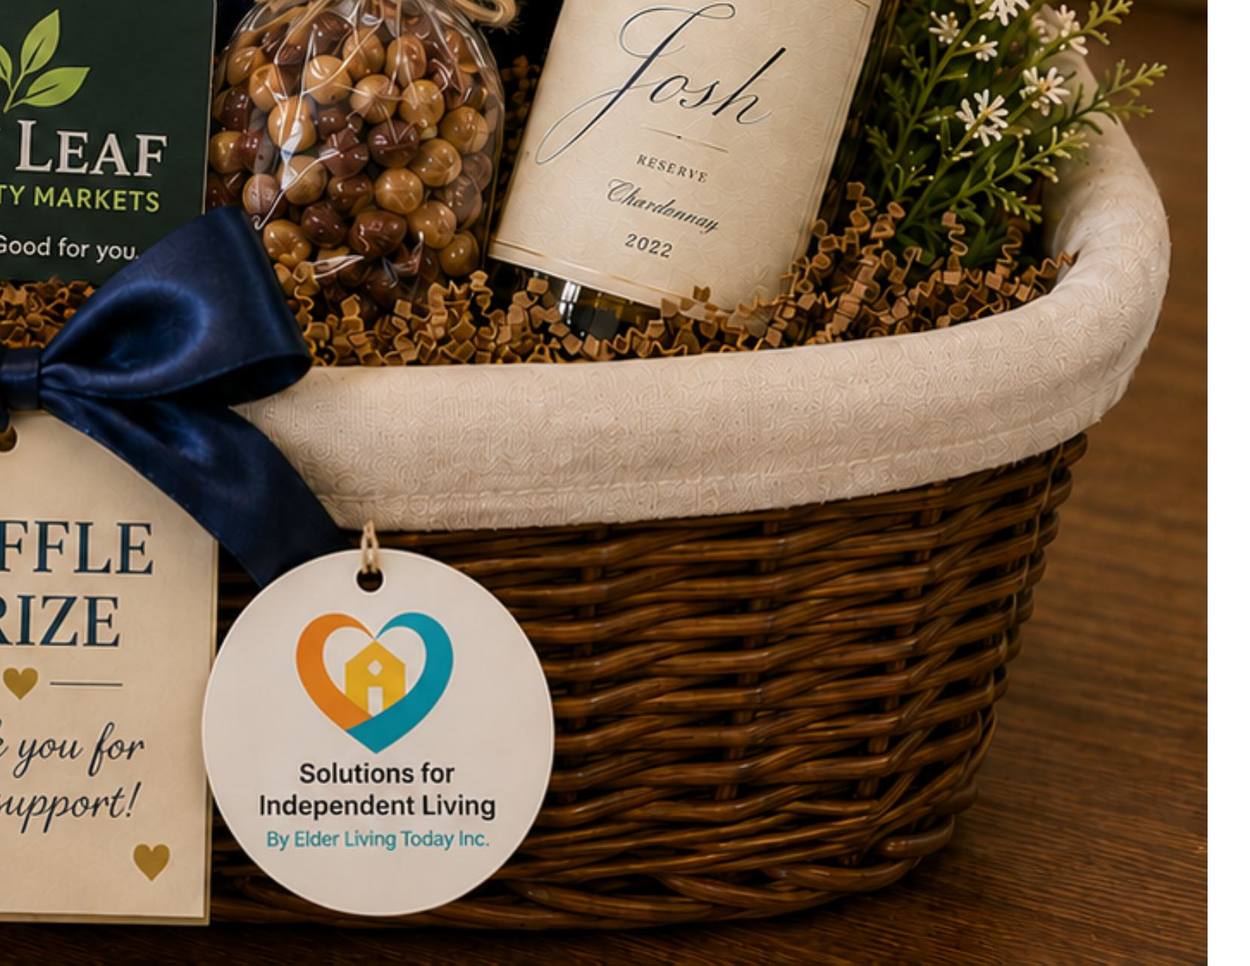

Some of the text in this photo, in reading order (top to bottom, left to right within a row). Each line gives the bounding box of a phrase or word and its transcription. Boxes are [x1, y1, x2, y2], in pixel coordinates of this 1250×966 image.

[535, 2, 787, 166] Josh
[15, 120, 168, 177] LEAF
[636, 153, 709, 184] RESERVE
[33, 187, 161, 213] MARKETS
[607, 178, 720, 234] Chardonnay
[58, 237, 90, 258] for
[95, 246, 140, 264] you.
[624, 233, 674, 259] 2022
[12, 738, 83, 778] you
[87, 721, 146, 777] for
[300, 762, 455, 784] Solutions for
[259, 794, 496, 821] Independent Living
[266, 830, 490, 851] By Elder Living Today Inc.
